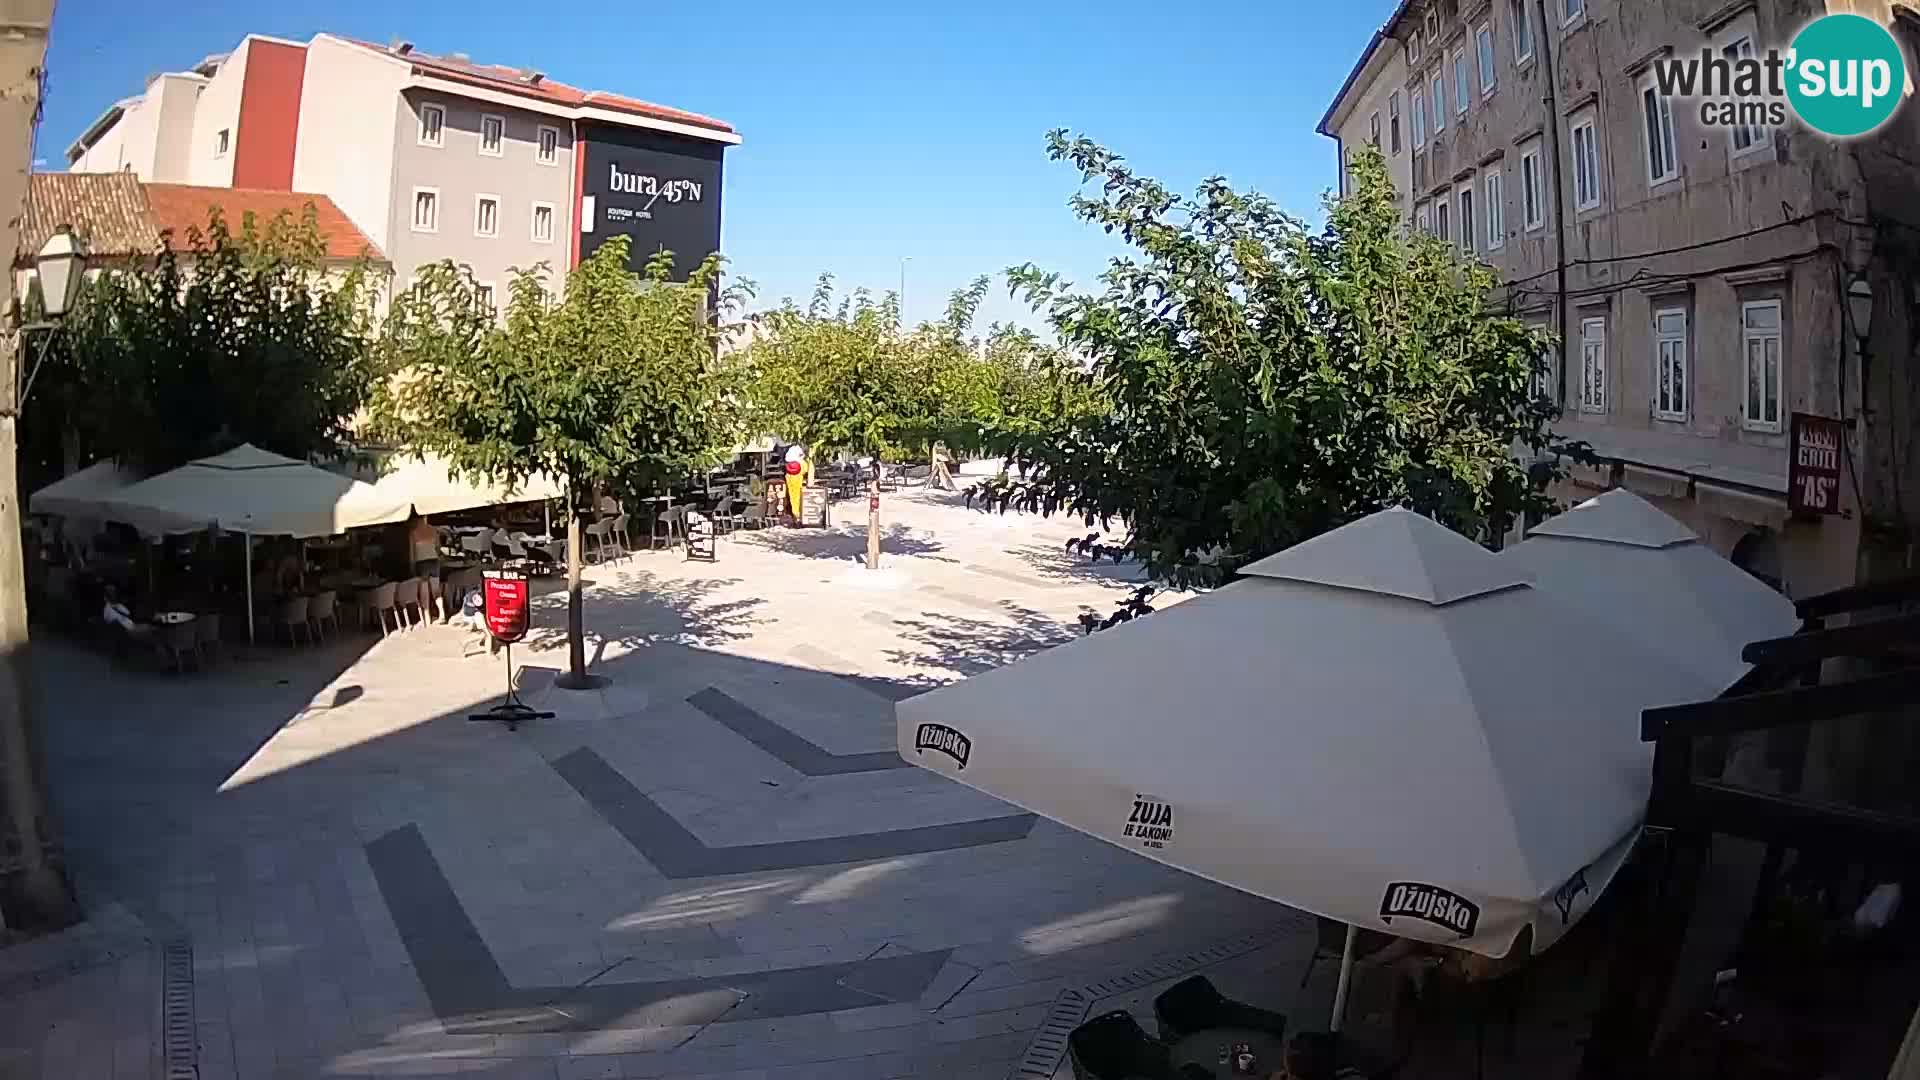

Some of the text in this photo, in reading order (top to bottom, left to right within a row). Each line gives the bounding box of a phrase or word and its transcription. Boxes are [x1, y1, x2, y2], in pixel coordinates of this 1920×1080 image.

[610, 164, 657, 196] bura
[635, 211, 652, 219] HOTEL
[503, 571, 519, 580] BAR
[1128, 794, 1172, 827] ŽUJA
[1123, 823, 1173, 841] JE ZAKON!
[1389, 885, 1471, 930] Ožujsko
